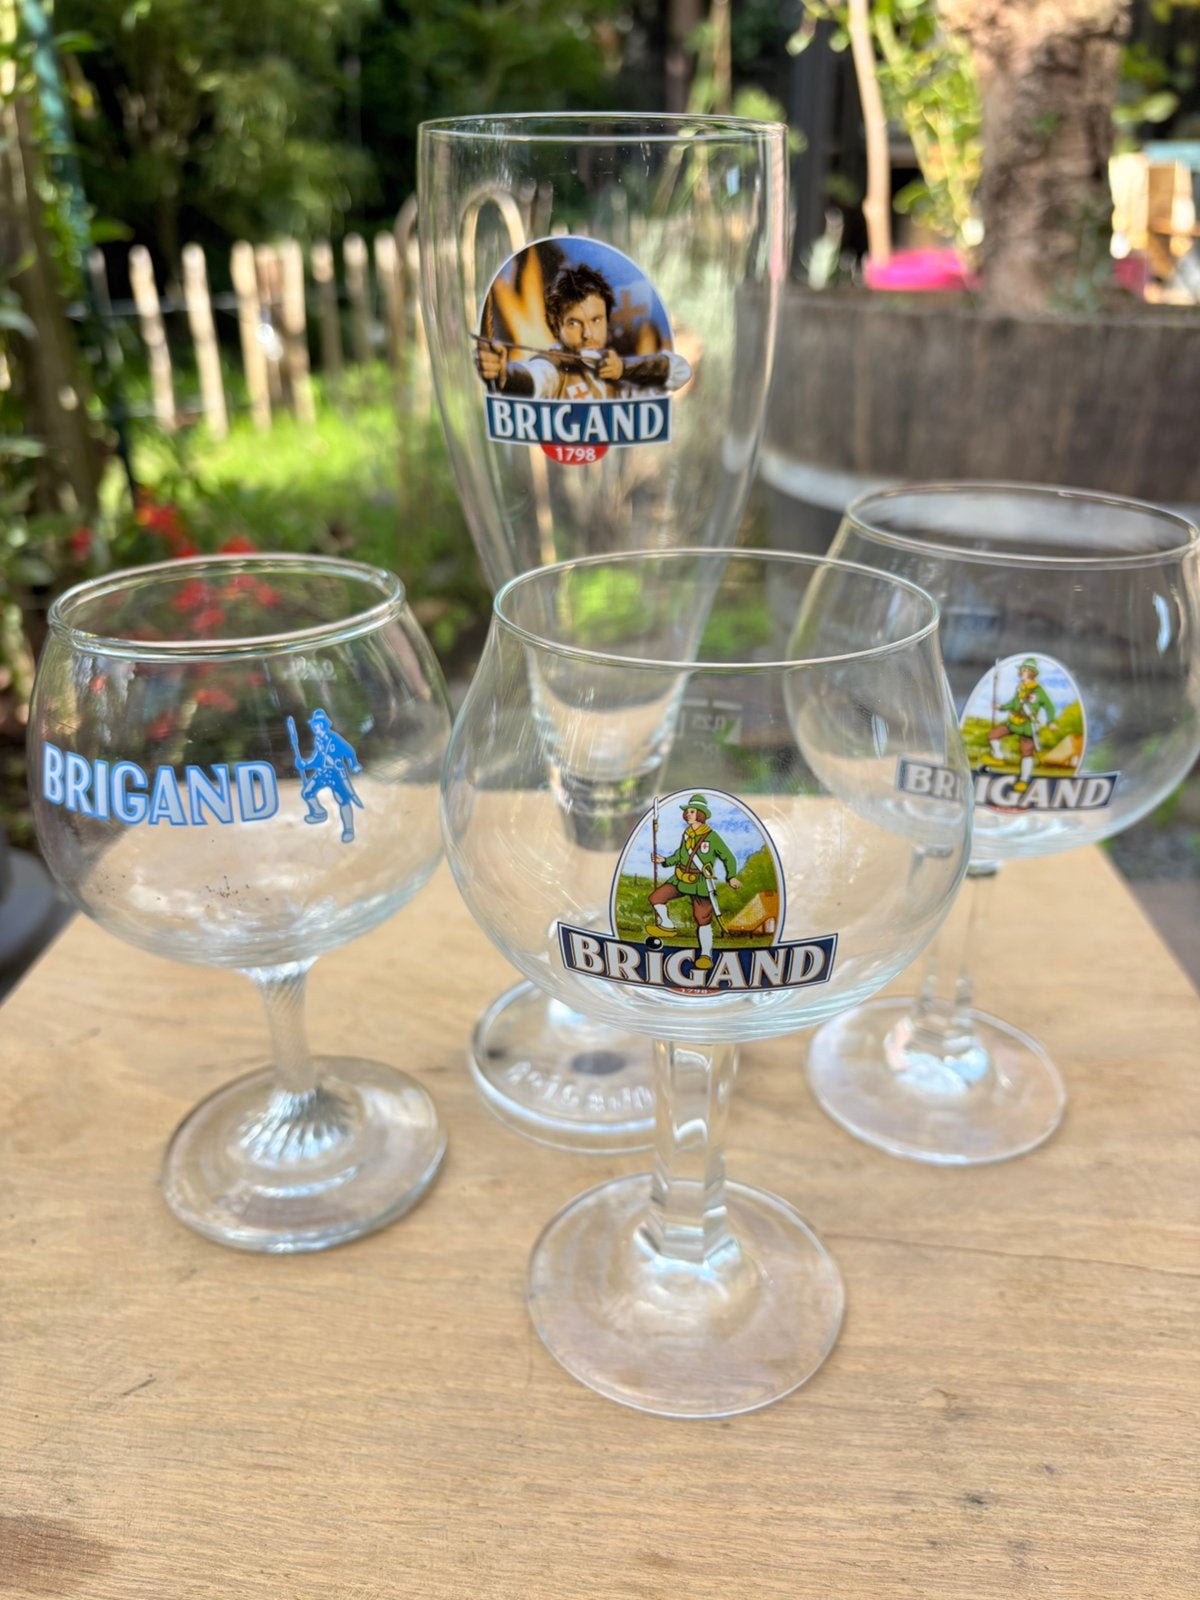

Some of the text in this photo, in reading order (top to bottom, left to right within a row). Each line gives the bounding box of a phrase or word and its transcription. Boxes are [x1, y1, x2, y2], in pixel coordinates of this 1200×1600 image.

[492, 399, 664, 443] BRIGAND
[554, 447, 597, 463] 1798
[42, 741, 279, 826] BRIGAND
[905, 763, 1112, 809] BRIGAND
[568, 931, 825, 988] BRIGAND
